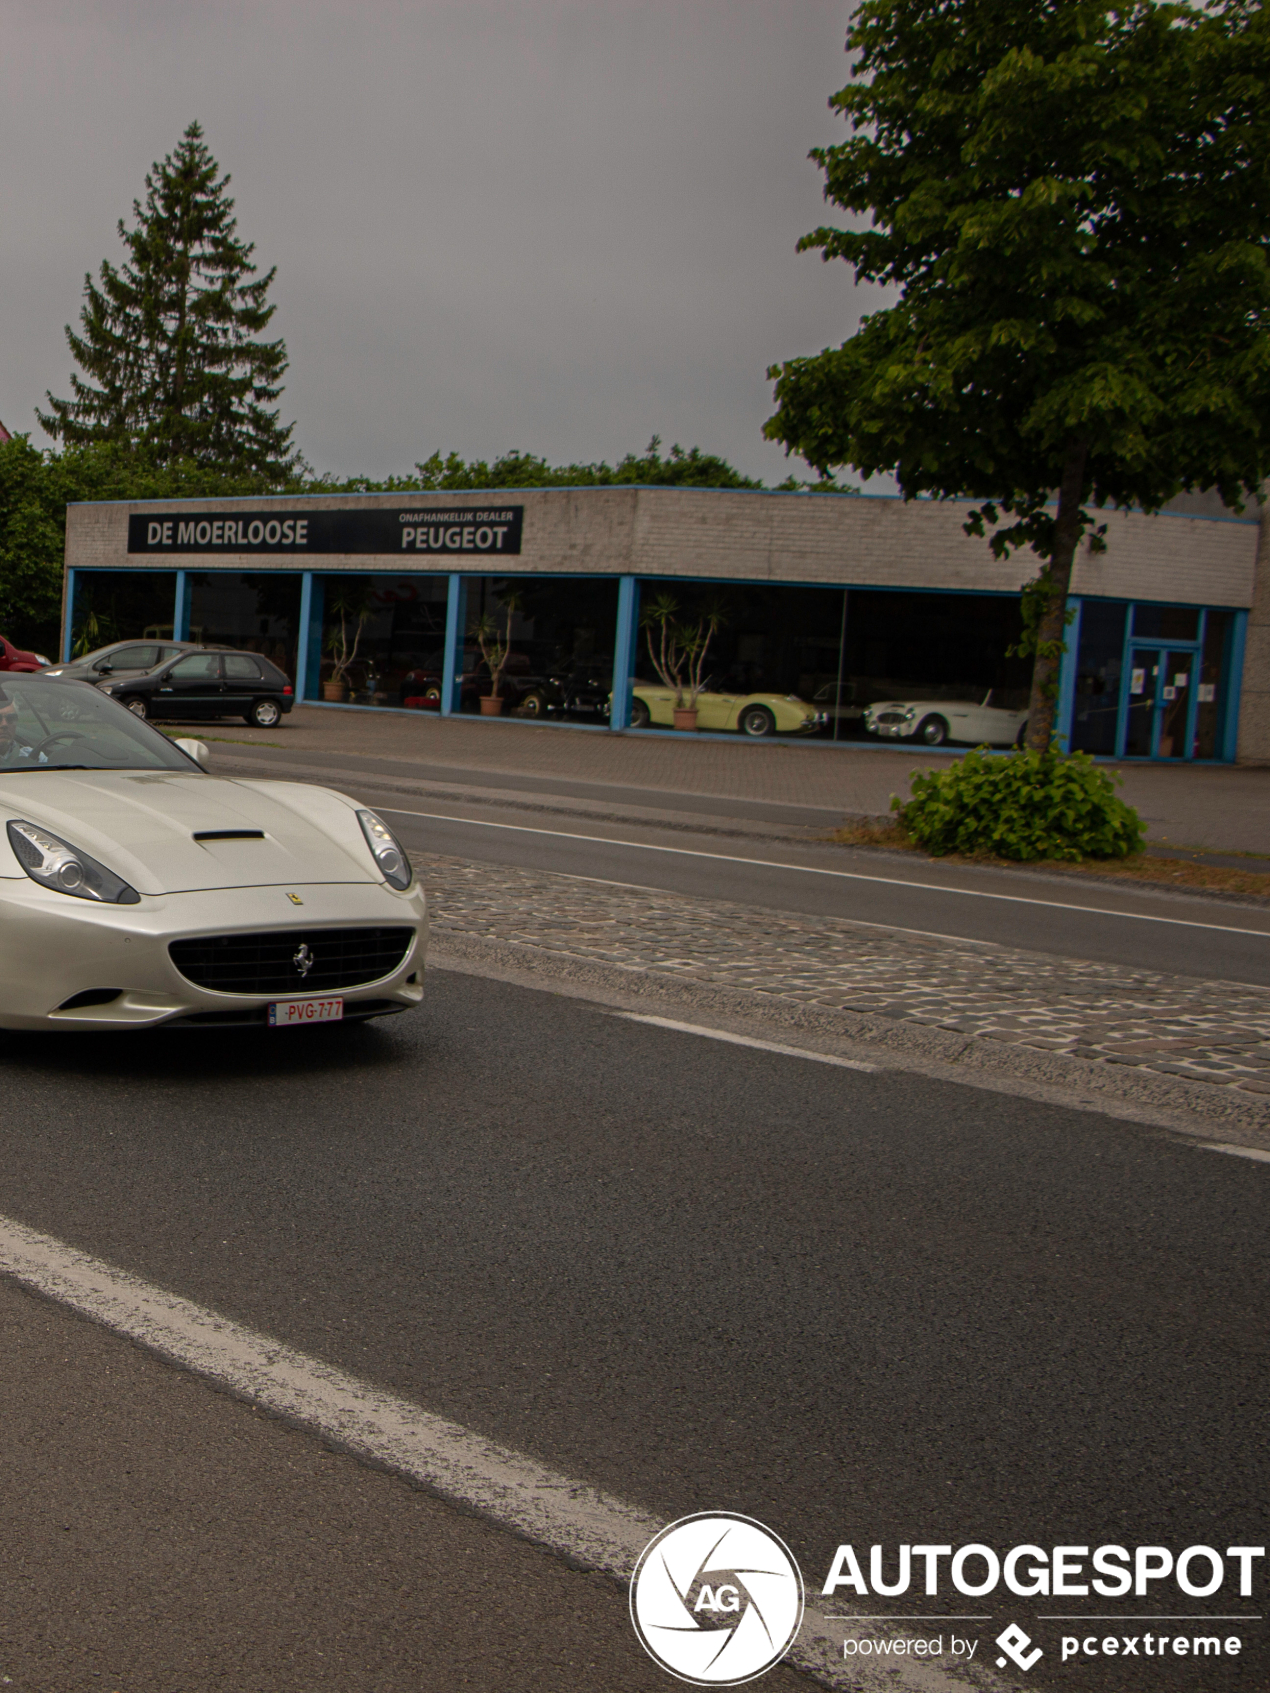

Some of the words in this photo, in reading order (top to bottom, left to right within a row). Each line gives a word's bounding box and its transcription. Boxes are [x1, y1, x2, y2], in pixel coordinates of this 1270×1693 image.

[399, 512, 473, 523] ONAFHANKELIJK
[476, 511, 513, 521] DEALER
[147, 522, 173, 545] DE
[177, 520, 308, 545] MOERLOOSE
[401, 526, 508, 549] PEUGEOT
[288, 1001, 342, 1021] PVG-777
